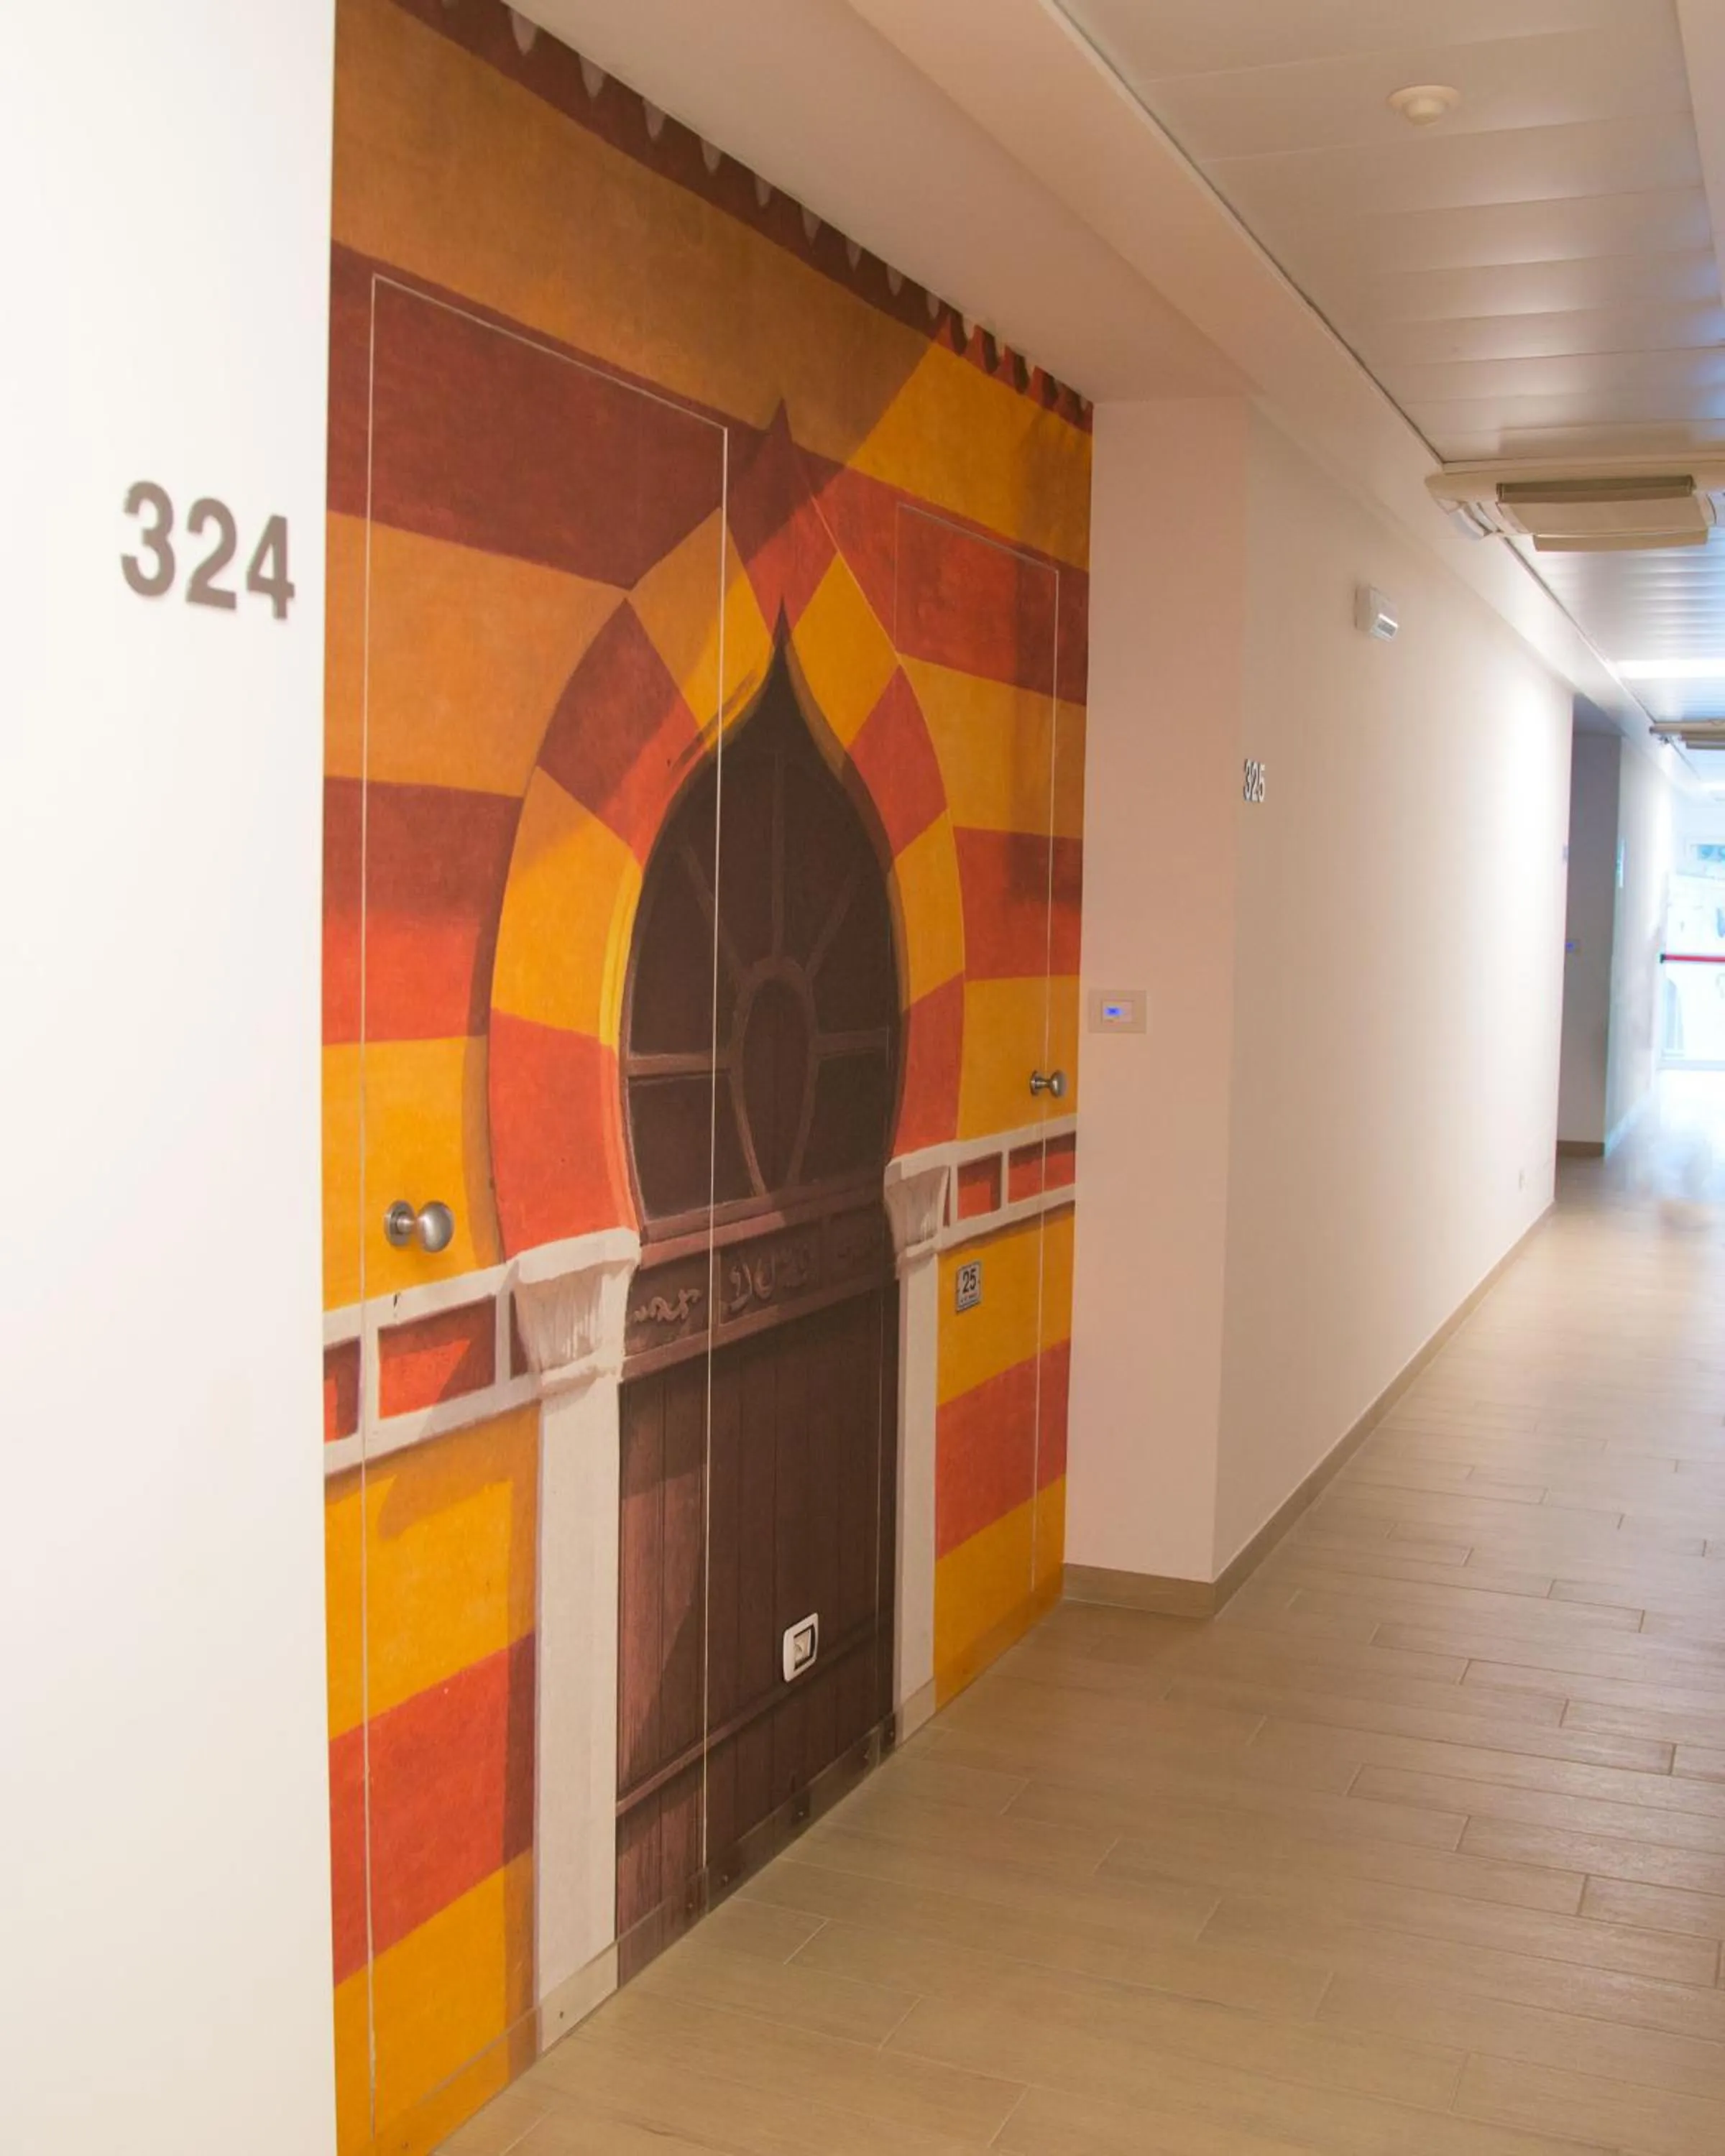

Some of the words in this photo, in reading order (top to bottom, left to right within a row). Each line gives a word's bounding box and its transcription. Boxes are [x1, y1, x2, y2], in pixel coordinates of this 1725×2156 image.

[121, 480, 295, 619] 324
[1243, 758, 1265, 803] 325
[962, 1268, 977, 1294] 25
